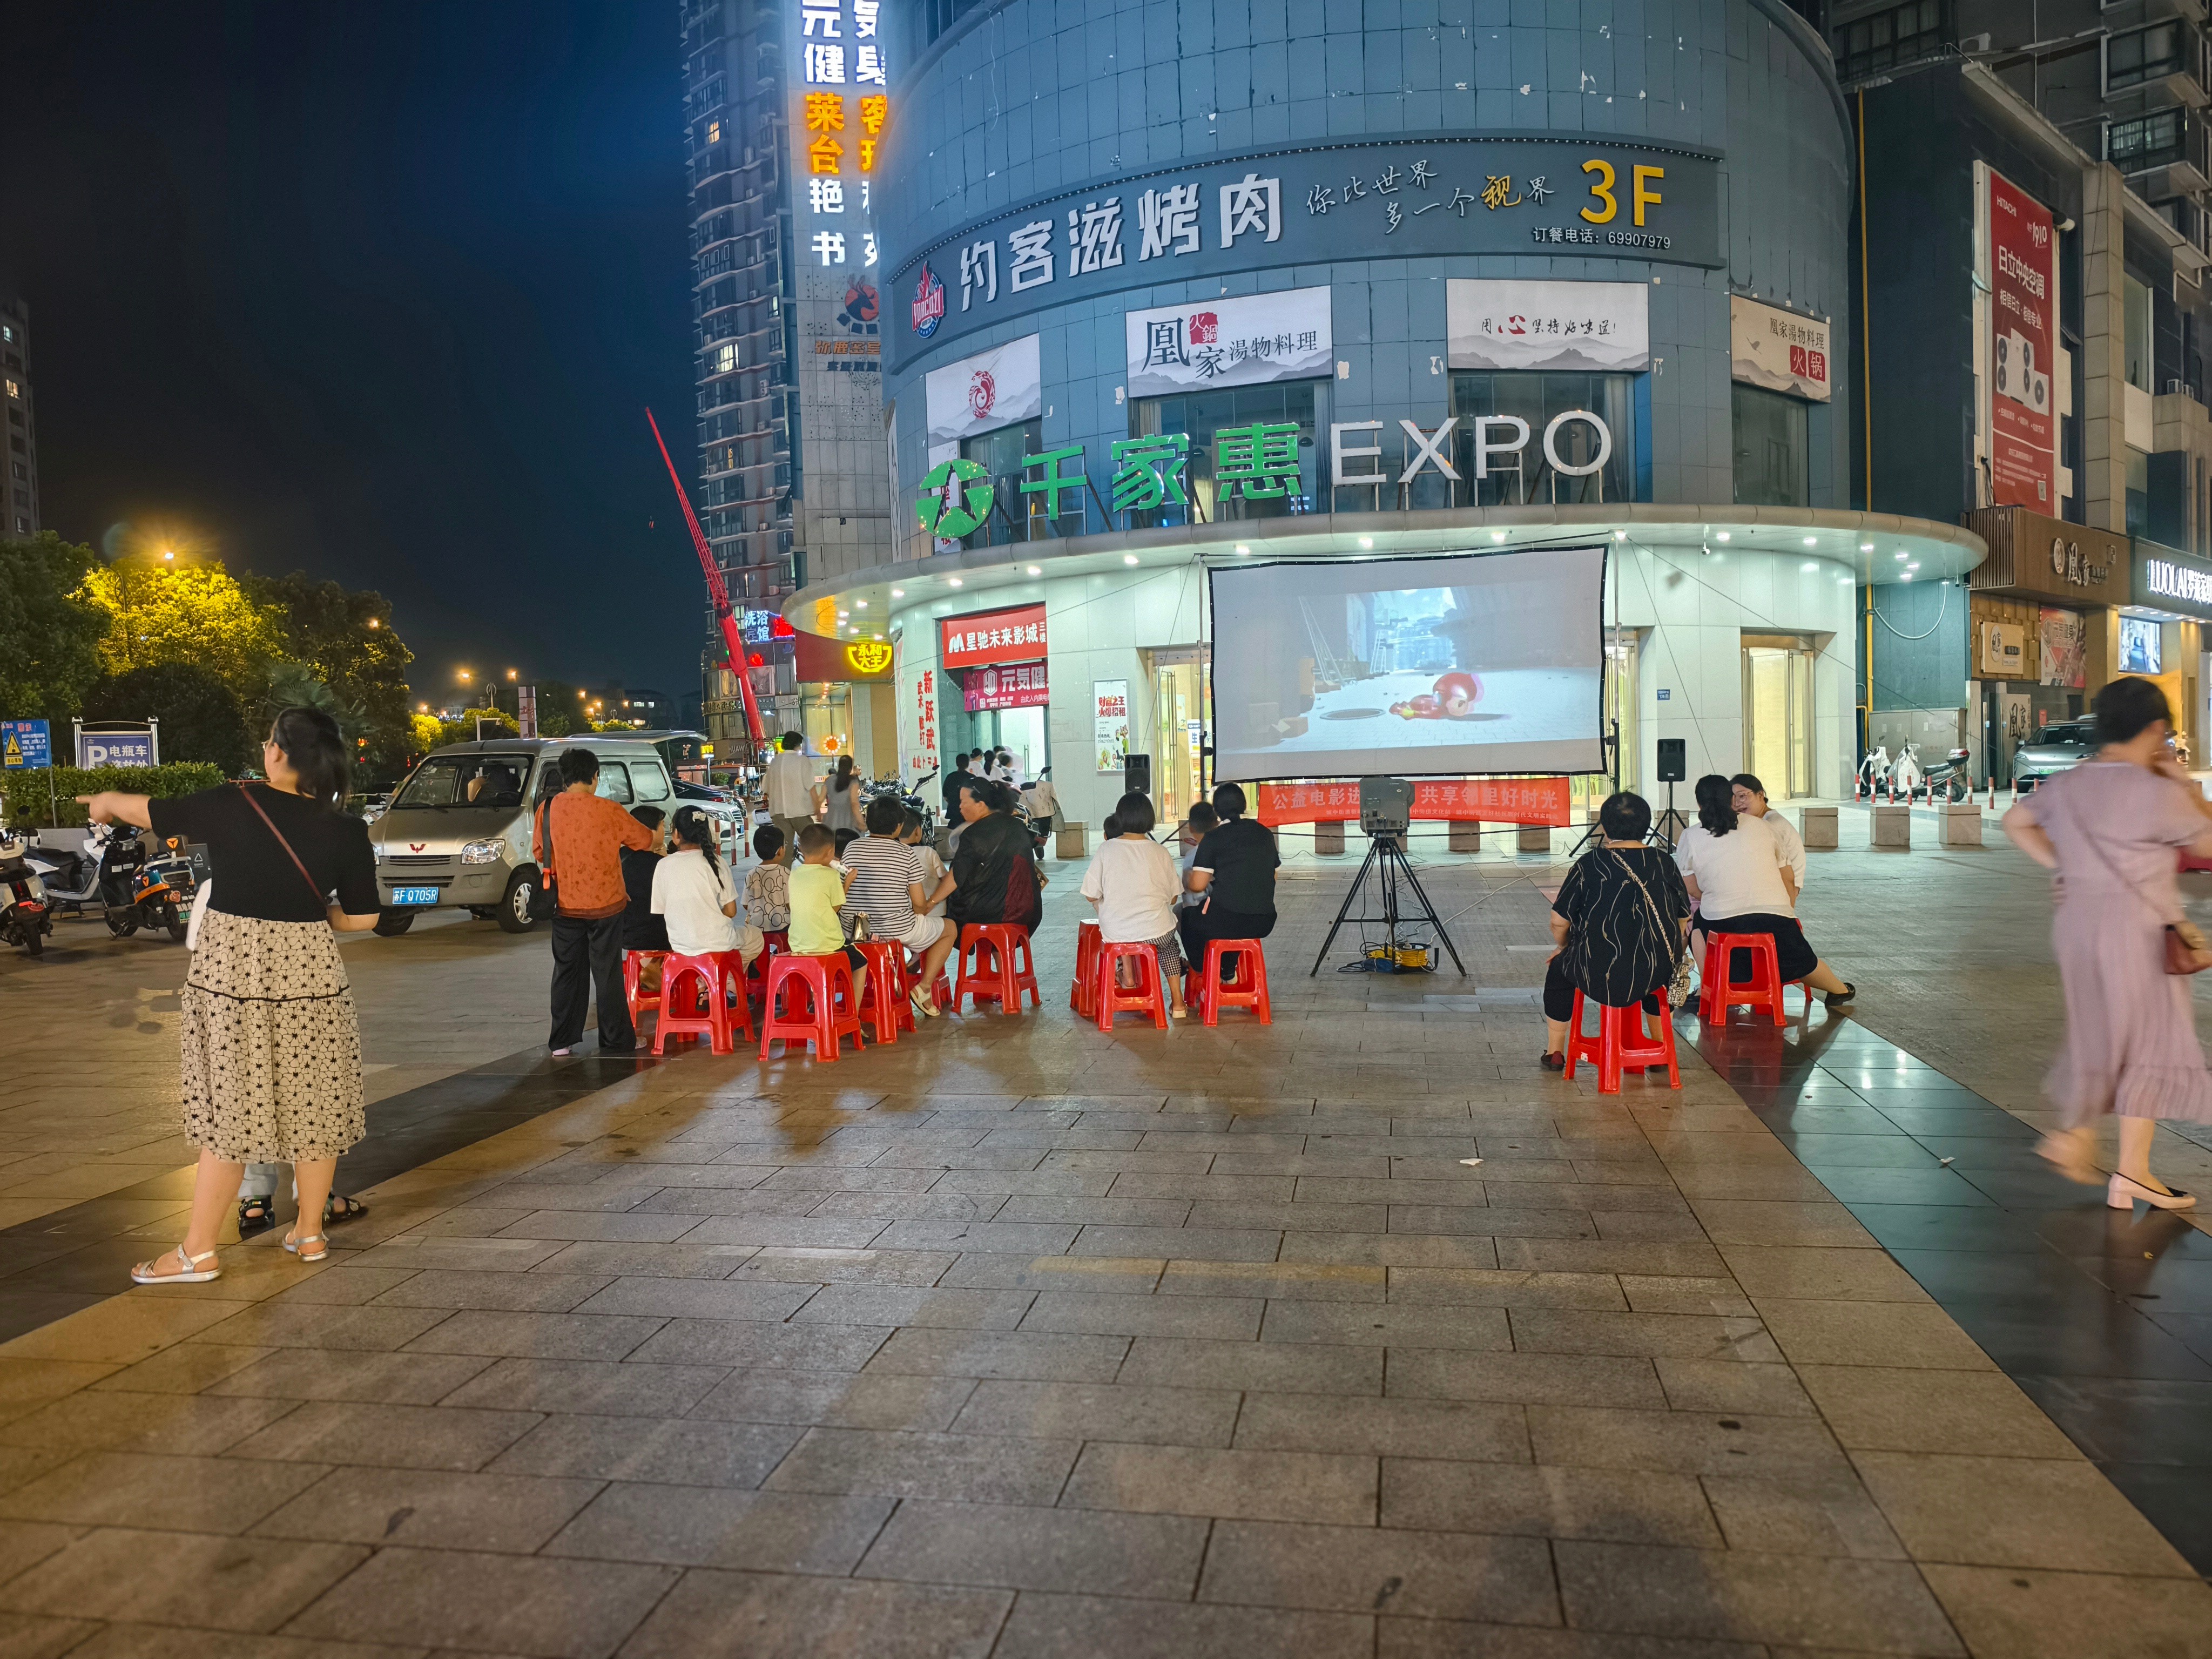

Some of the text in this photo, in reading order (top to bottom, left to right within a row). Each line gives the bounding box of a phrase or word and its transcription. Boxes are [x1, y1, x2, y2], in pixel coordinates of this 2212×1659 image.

[1385, 174, 1555, 234] 多一个视界
[1580, 159, 1665, 226] 3F
[1997, 195, 2017, 217] HITACHI
[960, 173, 1280, 313] 约客滋烤肉
[1608, 231, 1671, 249] 69907979
[2032, 221, 2047, 247] 1910
[1999, 244, 2045, 300] 日立中央空调
[1770, 317, 1824, 349] 凰家湯物料理
[1792, 348, 1823, 378] 火锅
[1331, 410, 1612, 486] EXPO
[1020, 422, 1302, 522] 千家惠
[2148, 559, 2187, 599] LUOLAI
[858, 644, 882, 656] 永和
[966, 623, 1038, 651] 星驰未来影城
[858, 656, 882, 668] 大王
[1020, 693, 1049, 703] 由此入内乘电
[87, 745, 108, 771] P
[109, 745, 147, 757] 电瓶车
[1421, 786, 1557, 809] 共享邻里好时光
